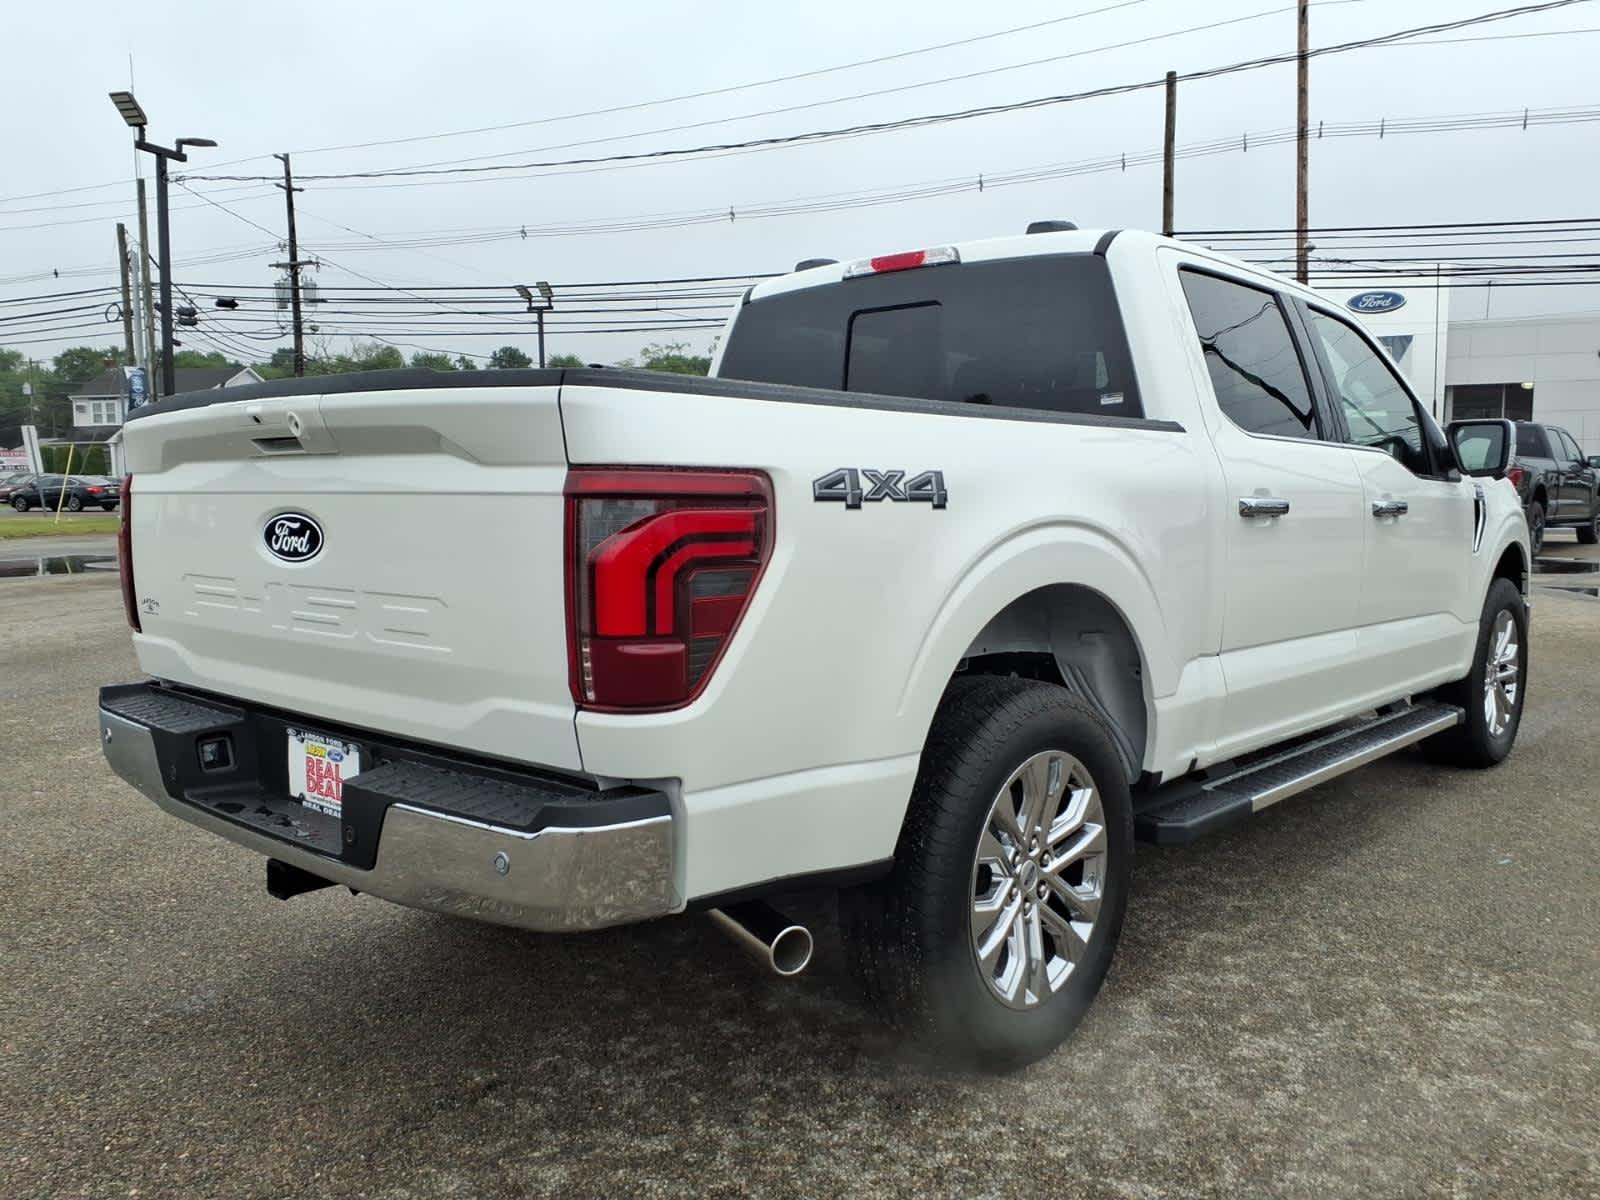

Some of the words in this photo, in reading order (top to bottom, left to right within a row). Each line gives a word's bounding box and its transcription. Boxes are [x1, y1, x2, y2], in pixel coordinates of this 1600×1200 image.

[1358, 294, 1393, 308] Ford
[271, 519, 310, 553] Ford
[305, 755, 344, 783] REAL
